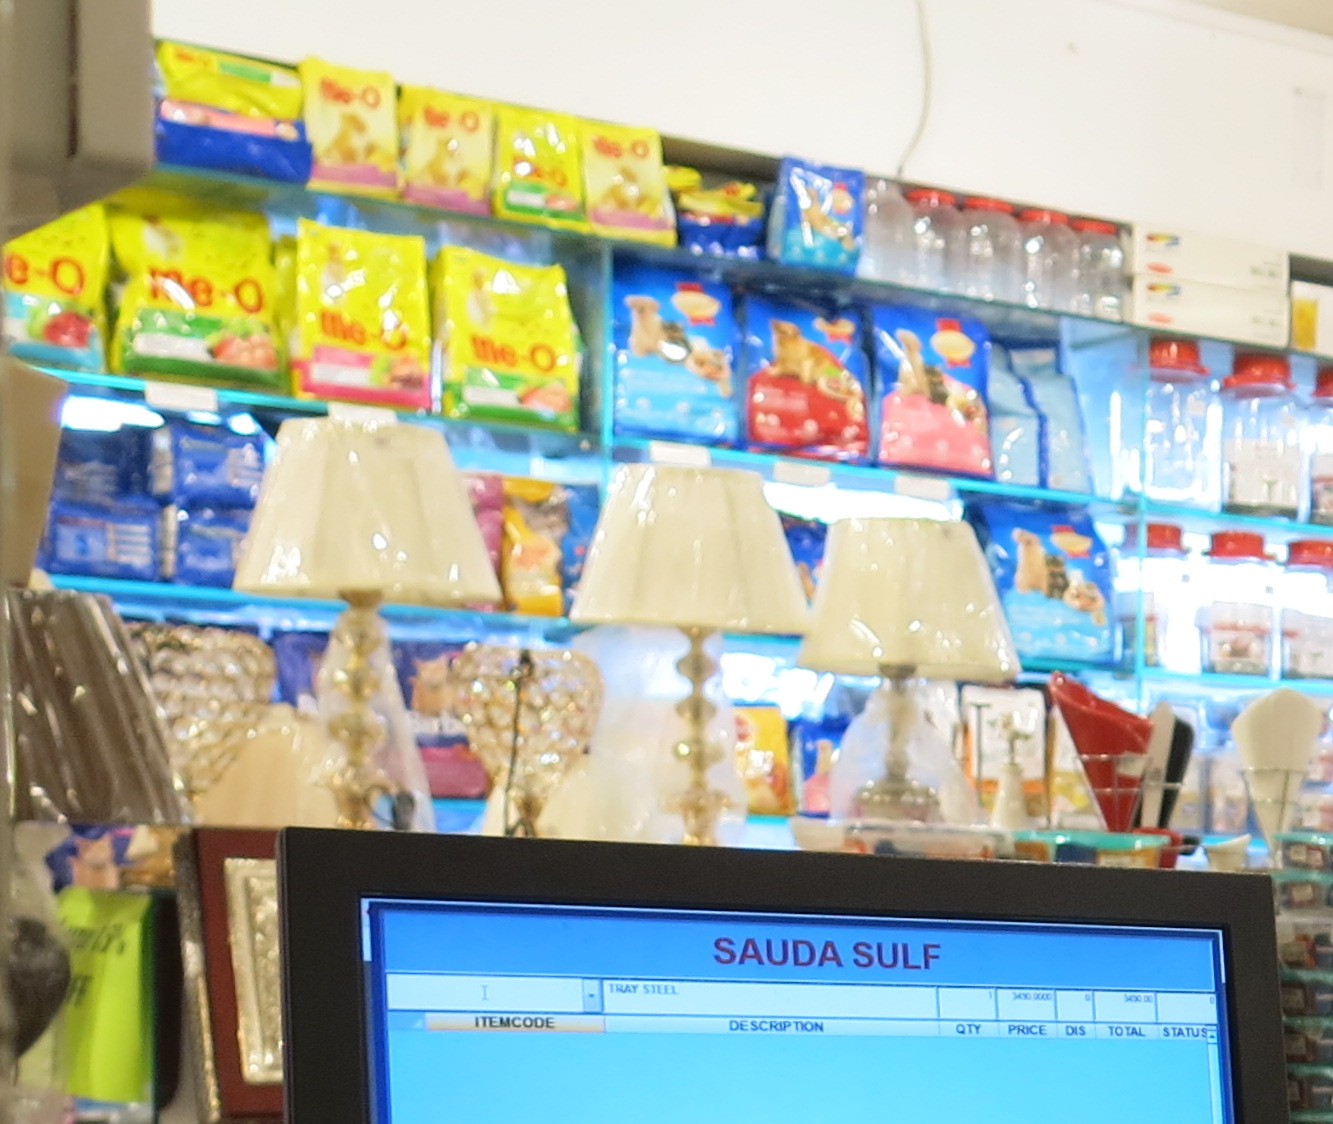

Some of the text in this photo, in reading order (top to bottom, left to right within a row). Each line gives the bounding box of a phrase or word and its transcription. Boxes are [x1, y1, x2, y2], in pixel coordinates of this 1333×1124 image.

[3, 253, 85, 296] e-O
[712, 936, 942, 970] SAUDA SULF
[608, 982, 678, 996] TRAY STEEL
[474, 1015, 556, 1029] ITEMCODE
[729, 1019, 825, 1033] DESCRIPTION
[955, 1023, 982, 1036] QTY
[1008, 1024, 1048, 1036] PRICE
[1065, 1025, 1087, 1036] DIS
[1108, 1025, 1147, 1038] TOTAL
[1162, 1027, 1208, 1039] STATUS
